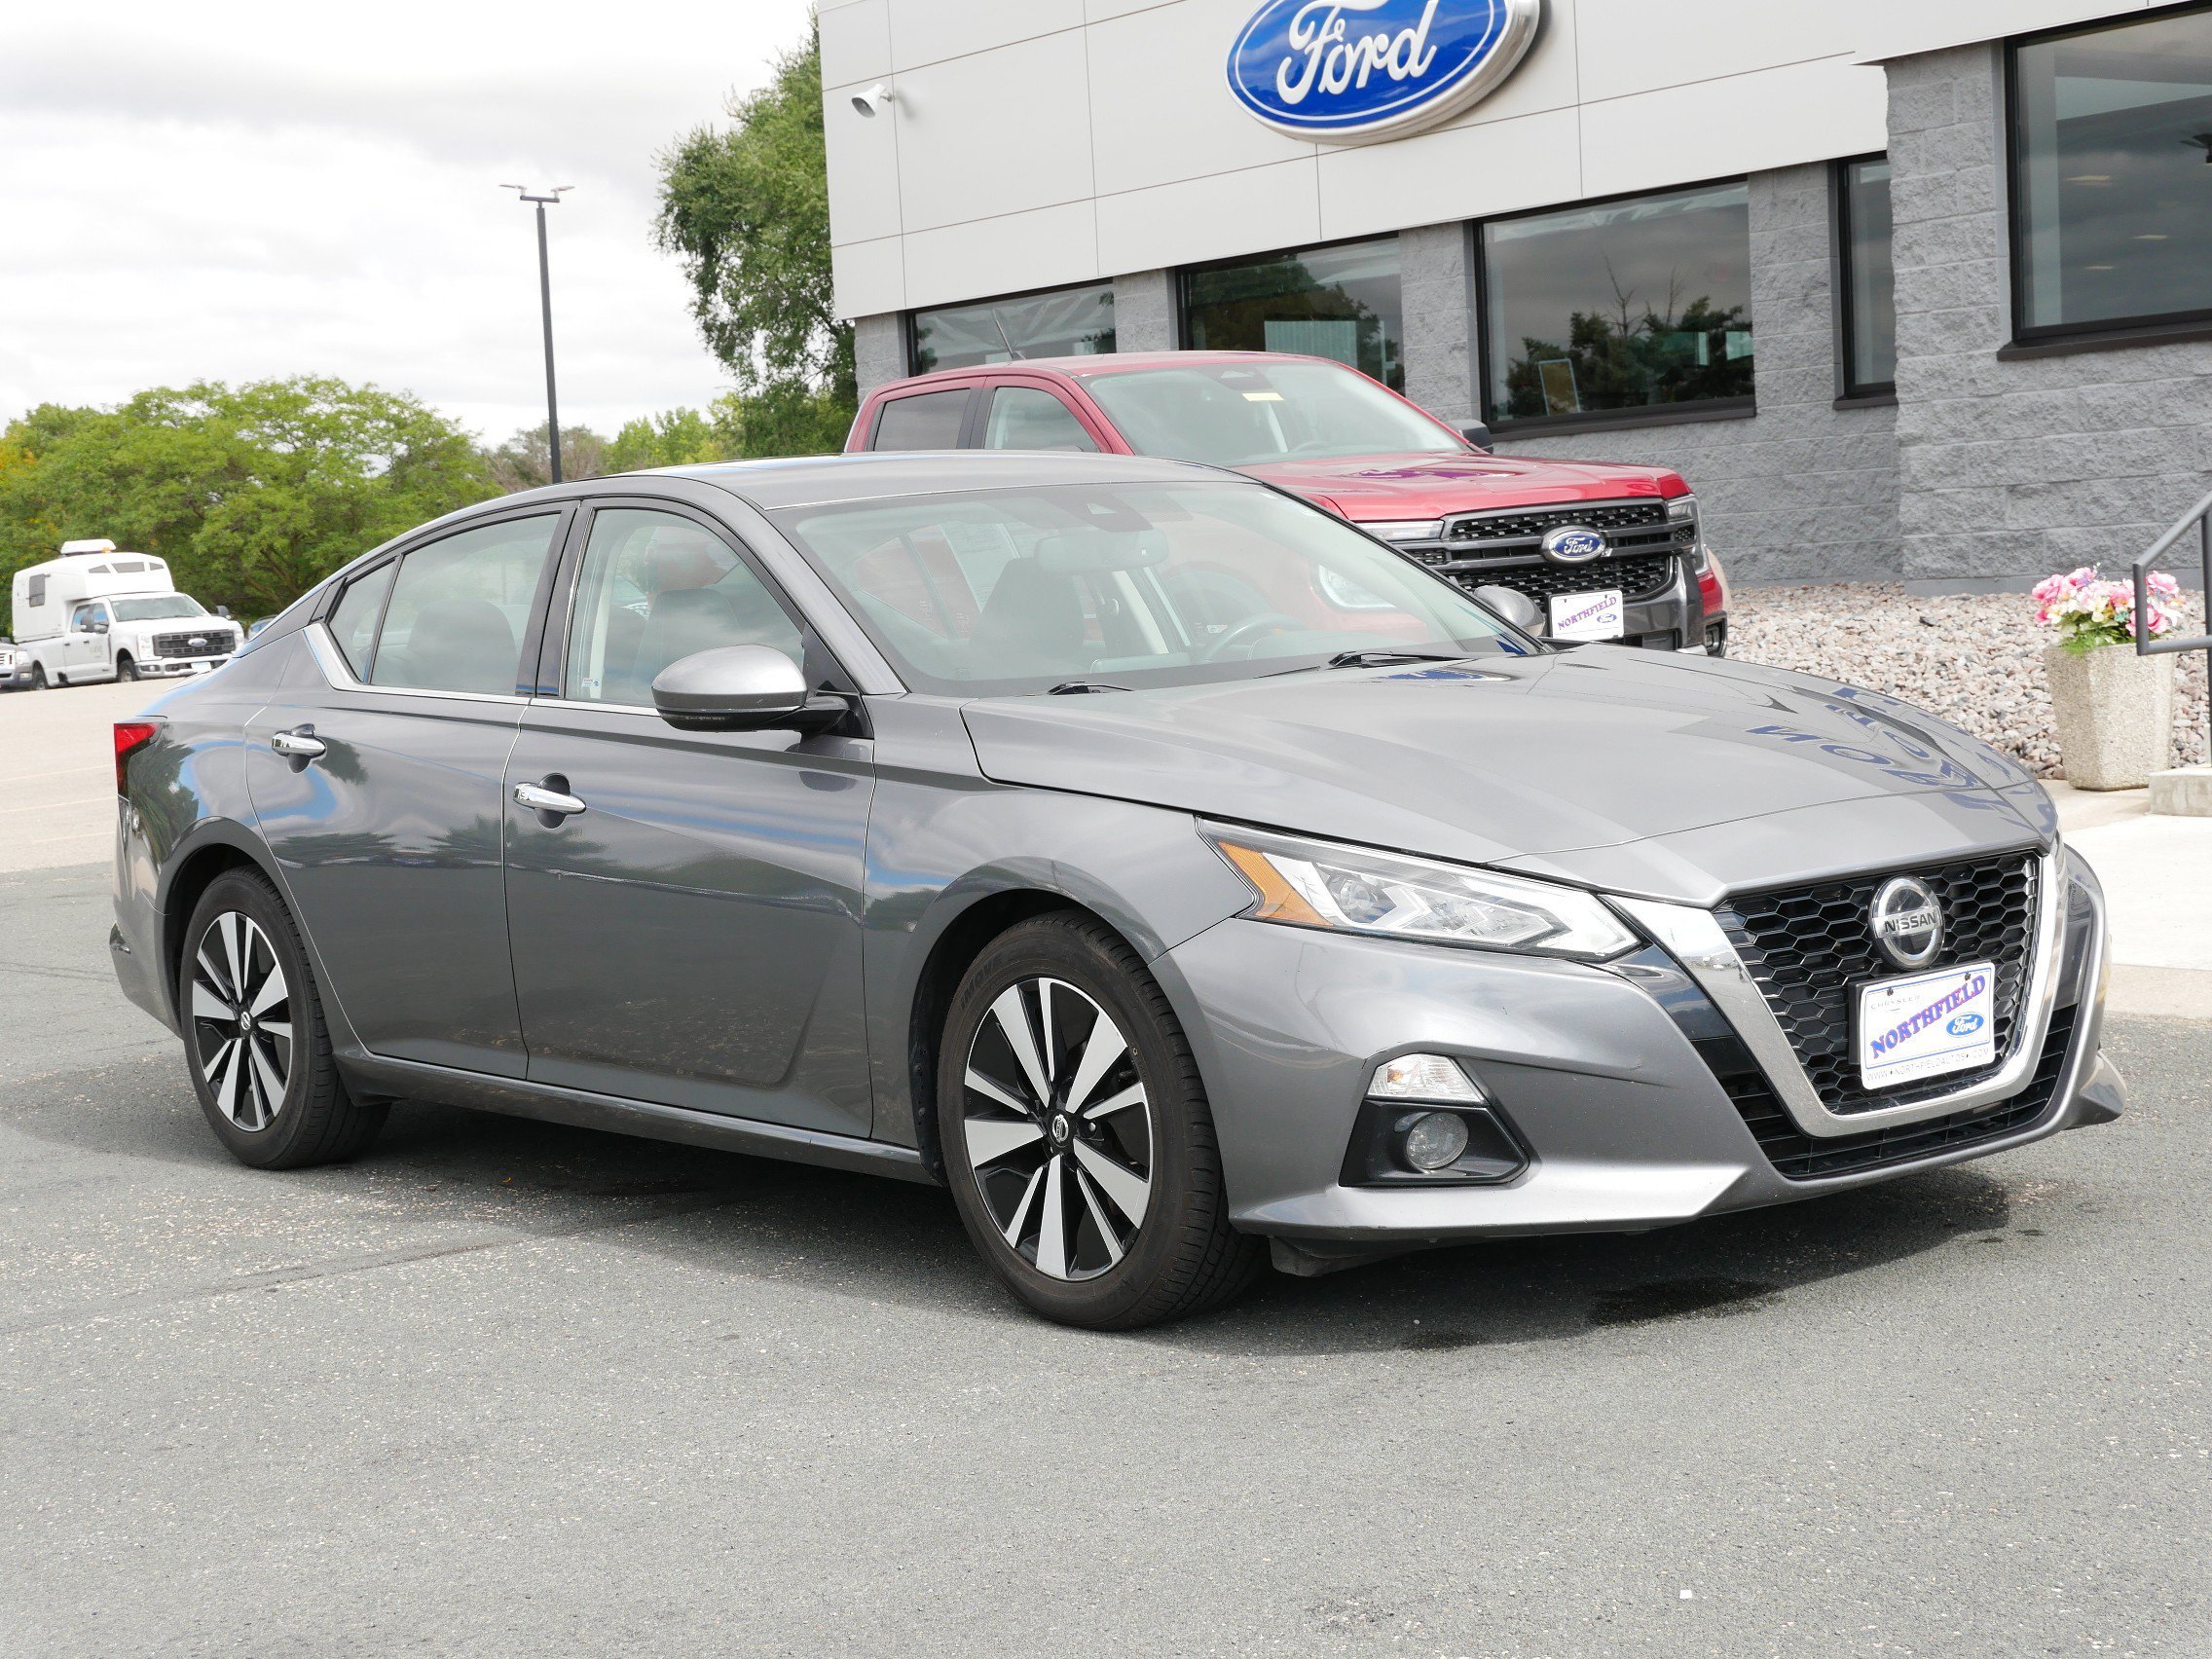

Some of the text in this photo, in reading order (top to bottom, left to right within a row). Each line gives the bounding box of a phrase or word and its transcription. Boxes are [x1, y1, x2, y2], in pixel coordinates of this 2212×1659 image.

[1276, 0, 1437, 105] Ford
[1564, 536, 1594, 555] Ford
[1558, 596, 1617, 630] NORTHFIELD
[1884, 911, 1936, 934] NISSAN
[1870, 976, 1986, 1059] NORTHFIELD
[1952, 1014, 1978, 1034] Ford
